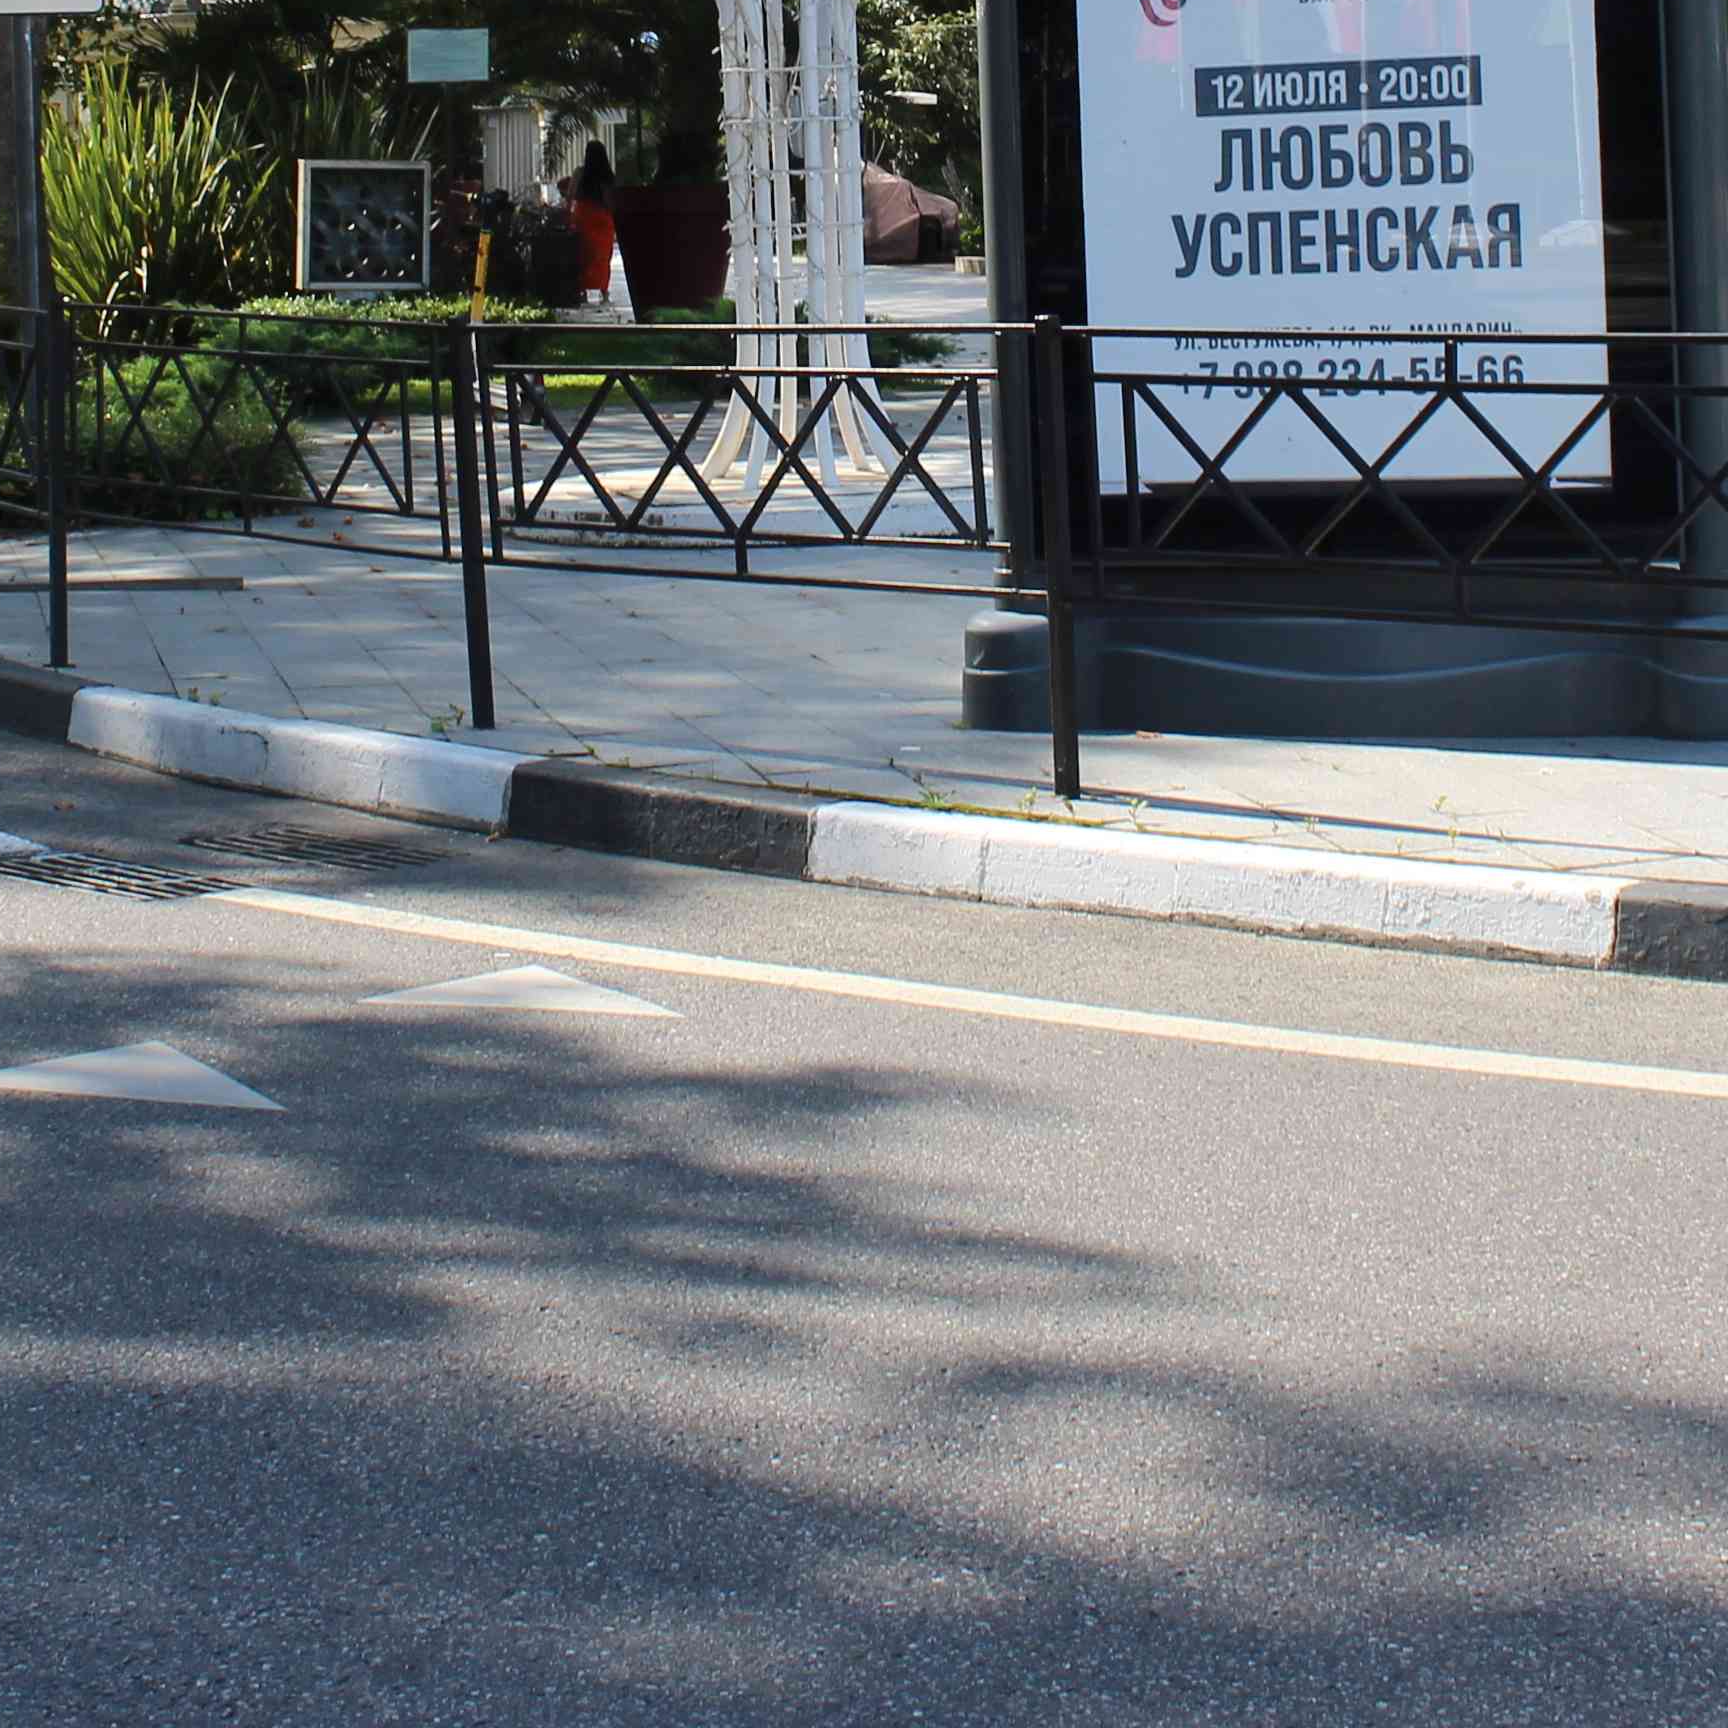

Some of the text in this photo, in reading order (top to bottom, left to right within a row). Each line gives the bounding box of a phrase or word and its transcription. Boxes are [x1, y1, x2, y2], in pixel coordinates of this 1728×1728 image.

[1210, 63, 1471, 110] 12 ИЮЛЯ 20:00
[1213, 119, 1475, 193] ЛЮБОВЬ
[1171, 202, 1524, 279] УСПЕНСКАЯ
